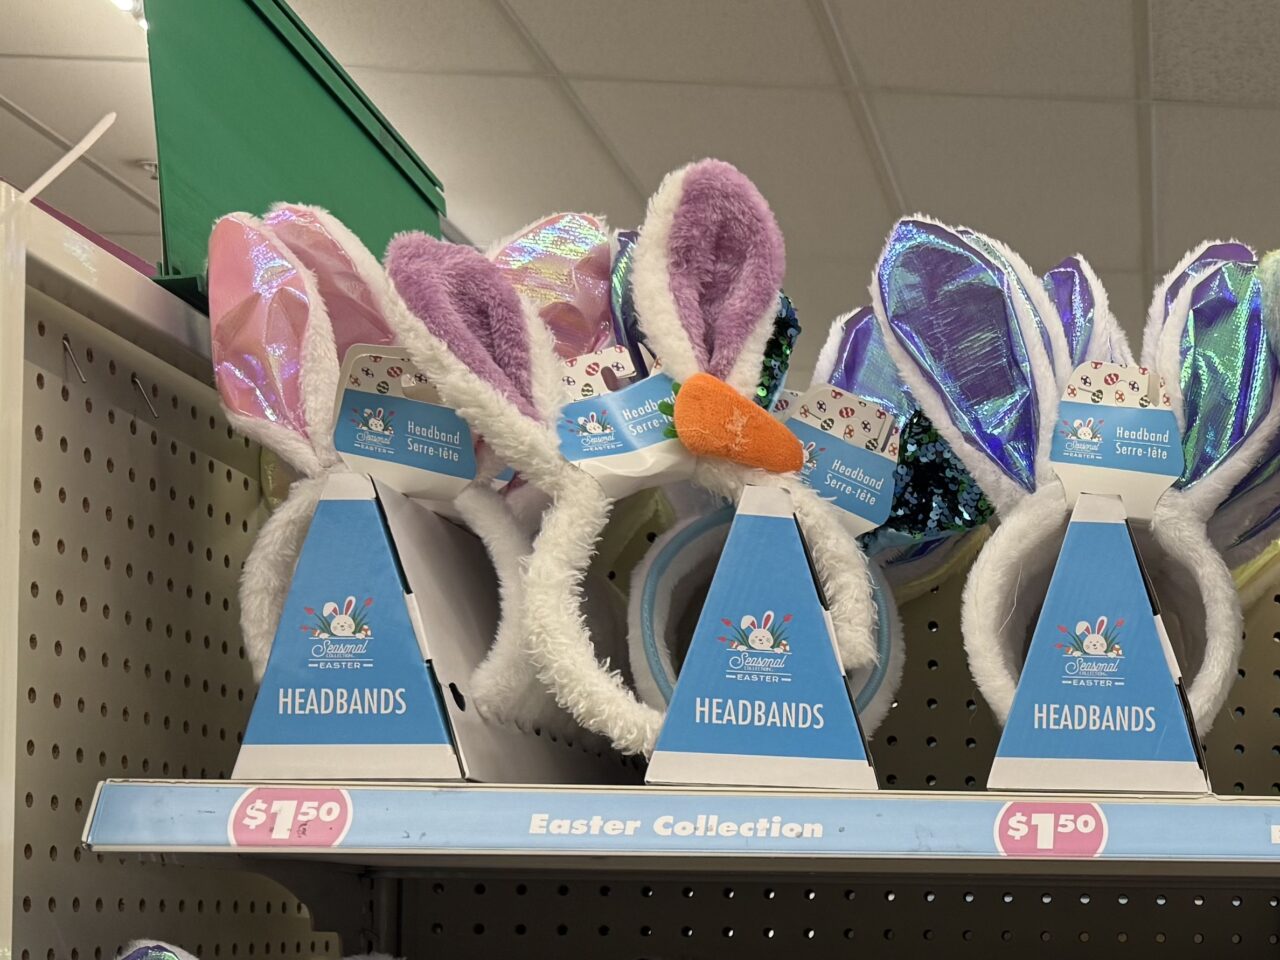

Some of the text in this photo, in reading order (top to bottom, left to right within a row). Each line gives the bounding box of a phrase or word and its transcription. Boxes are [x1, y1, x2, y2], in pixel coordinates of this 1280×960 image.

[407, 421, 460, 444] Headband
[1116, 426, 1169, 443] Headband
[407, 438, 459, 461] Serre-tête
[1115, 443, 1168, 460] Serre-tête
[831, 459, 884, 490] Headband
[824, 473, 876, 505] Serre-tête
[311, 639, 369, 658] Seasonal
[729, 652, 787, 669] Seasonal
[1065, 657, 1120, 675] Seasonal
[737, 674, 779, 683] EASTER
[1072, 679, 1112, 687] EASTER
[278, 688, 407, 715] HEADBANDS
[695, 697, 825, 729] HEADBANDS
[1034, 703, 1156, 732] HEADBANDS
[528, 813, 823, 838] Easter Collection
